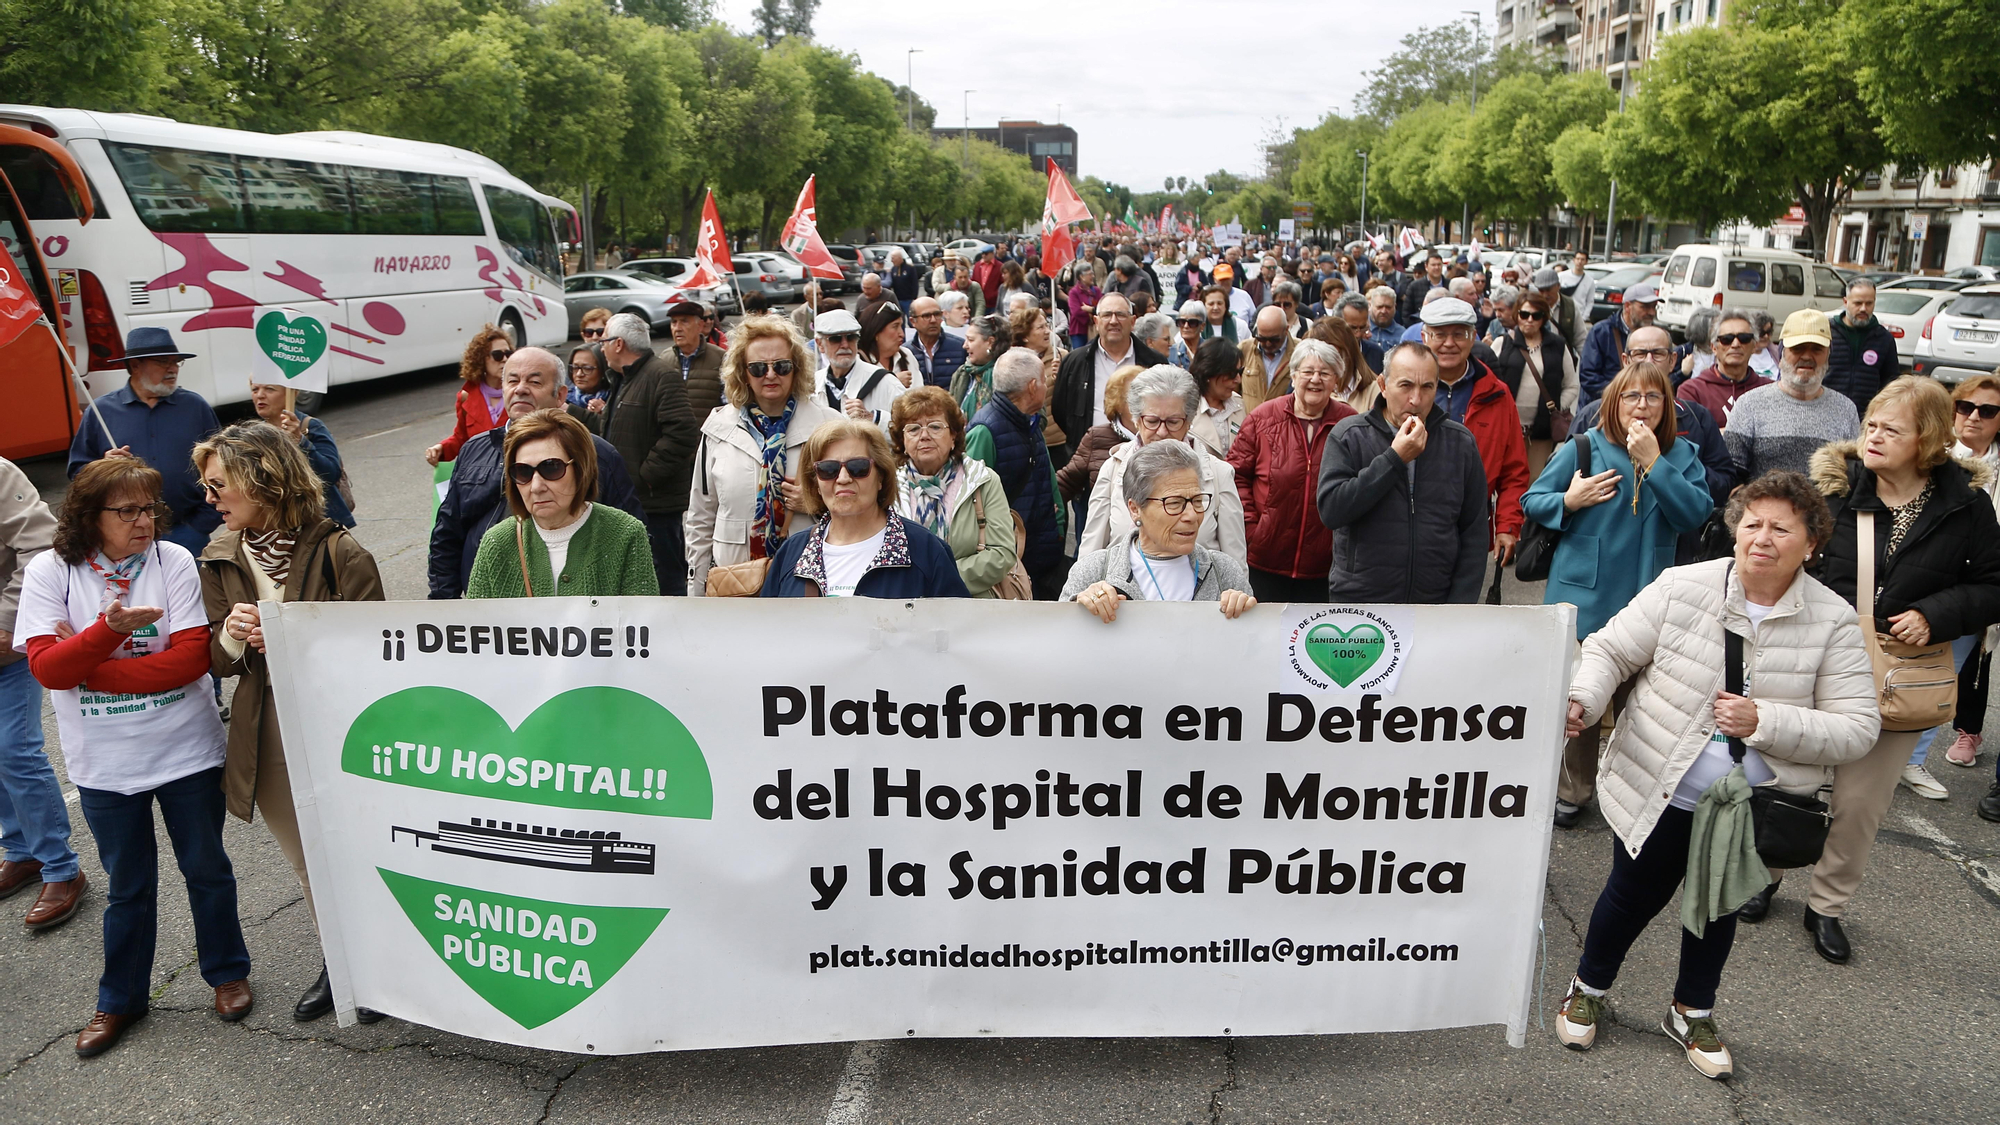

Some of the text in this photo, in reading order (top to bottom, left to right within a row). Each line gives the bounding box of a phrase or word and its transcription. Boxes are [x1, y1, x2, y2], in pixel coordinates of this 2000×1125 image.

[374, 255, 451, 275] NAVARRO
[1298, 619, 1309, 629] DE
[1329, 607, 1365, 616] MAREAS
[1366, 611, 1398, 641] BLANCAS
[382, 623, 650, 661] ¡¡ DEFIENDE !!
[1289, 645, 1295, 656] LA
[1290, 629, 1299, 643] ILP
[1348, 636, 1385, 644] PÚBLICA
[1393, 642, 1400, 653] DE
[1332, 649, 1366, 659] 100%
[1291, 658, 1328, 690] APOYAMOS
[1360, 655, 1399, 690] ANDALUCÍA
[80, 695, 93, 704] del
[81, 692, 186, 716] y la Sanidad Pública
[761, 684, 1528, 743] Plataforma en Defensa
[372, 741, 668, 800] ¡¡TU HOSPITAL!!
[753, 767, 1529, 830] del Hospital de Montilla
[809, 846, 1466, 911] y la Sanidad Pública
[433, 893, 597, 946] SANIDAD
[443, 931, 593, 989] PÚBLICA
[809, 937, 1459, 974] plat.sanidadhospitalmontilla@gmail.com
